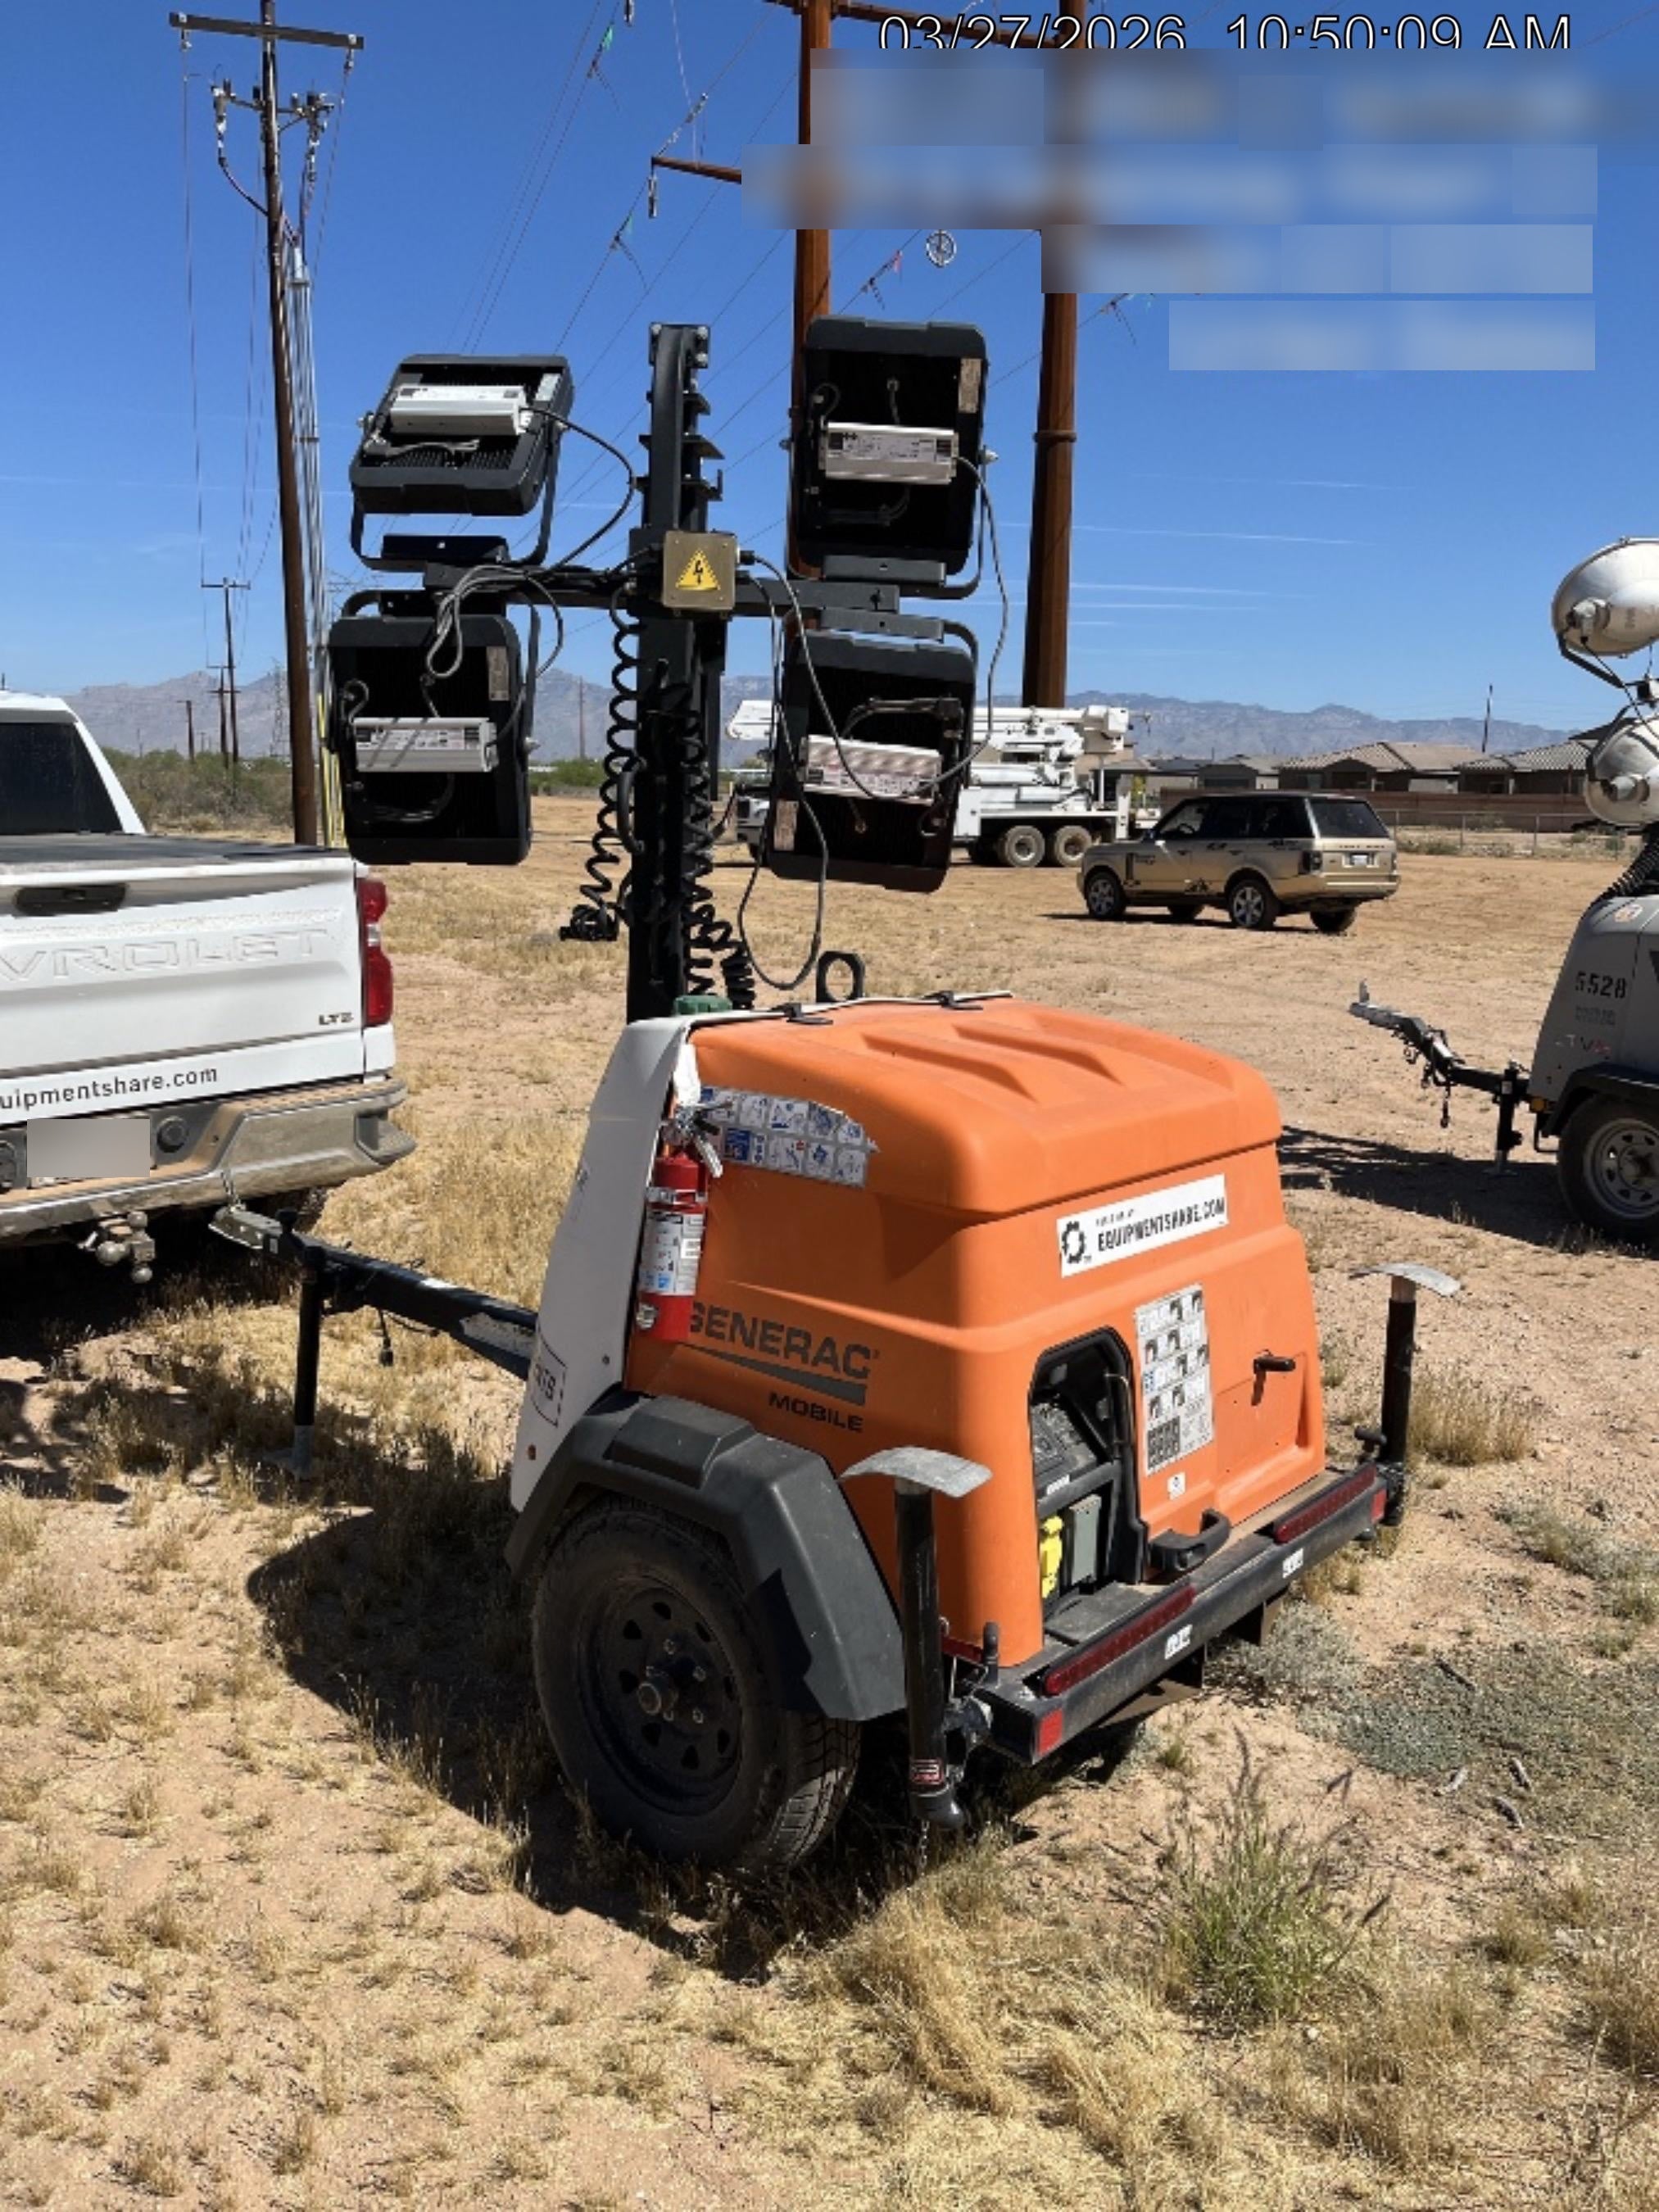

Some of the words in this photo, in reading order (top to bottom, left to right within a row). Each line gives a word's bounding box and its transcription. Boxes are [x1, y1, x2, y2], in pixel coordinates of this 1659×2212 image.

[1575, 970, 1627, 999] 5528
[319, 1012, 354, 1025] LTZ
[768, 1392, 864, 1432] MOBILE
